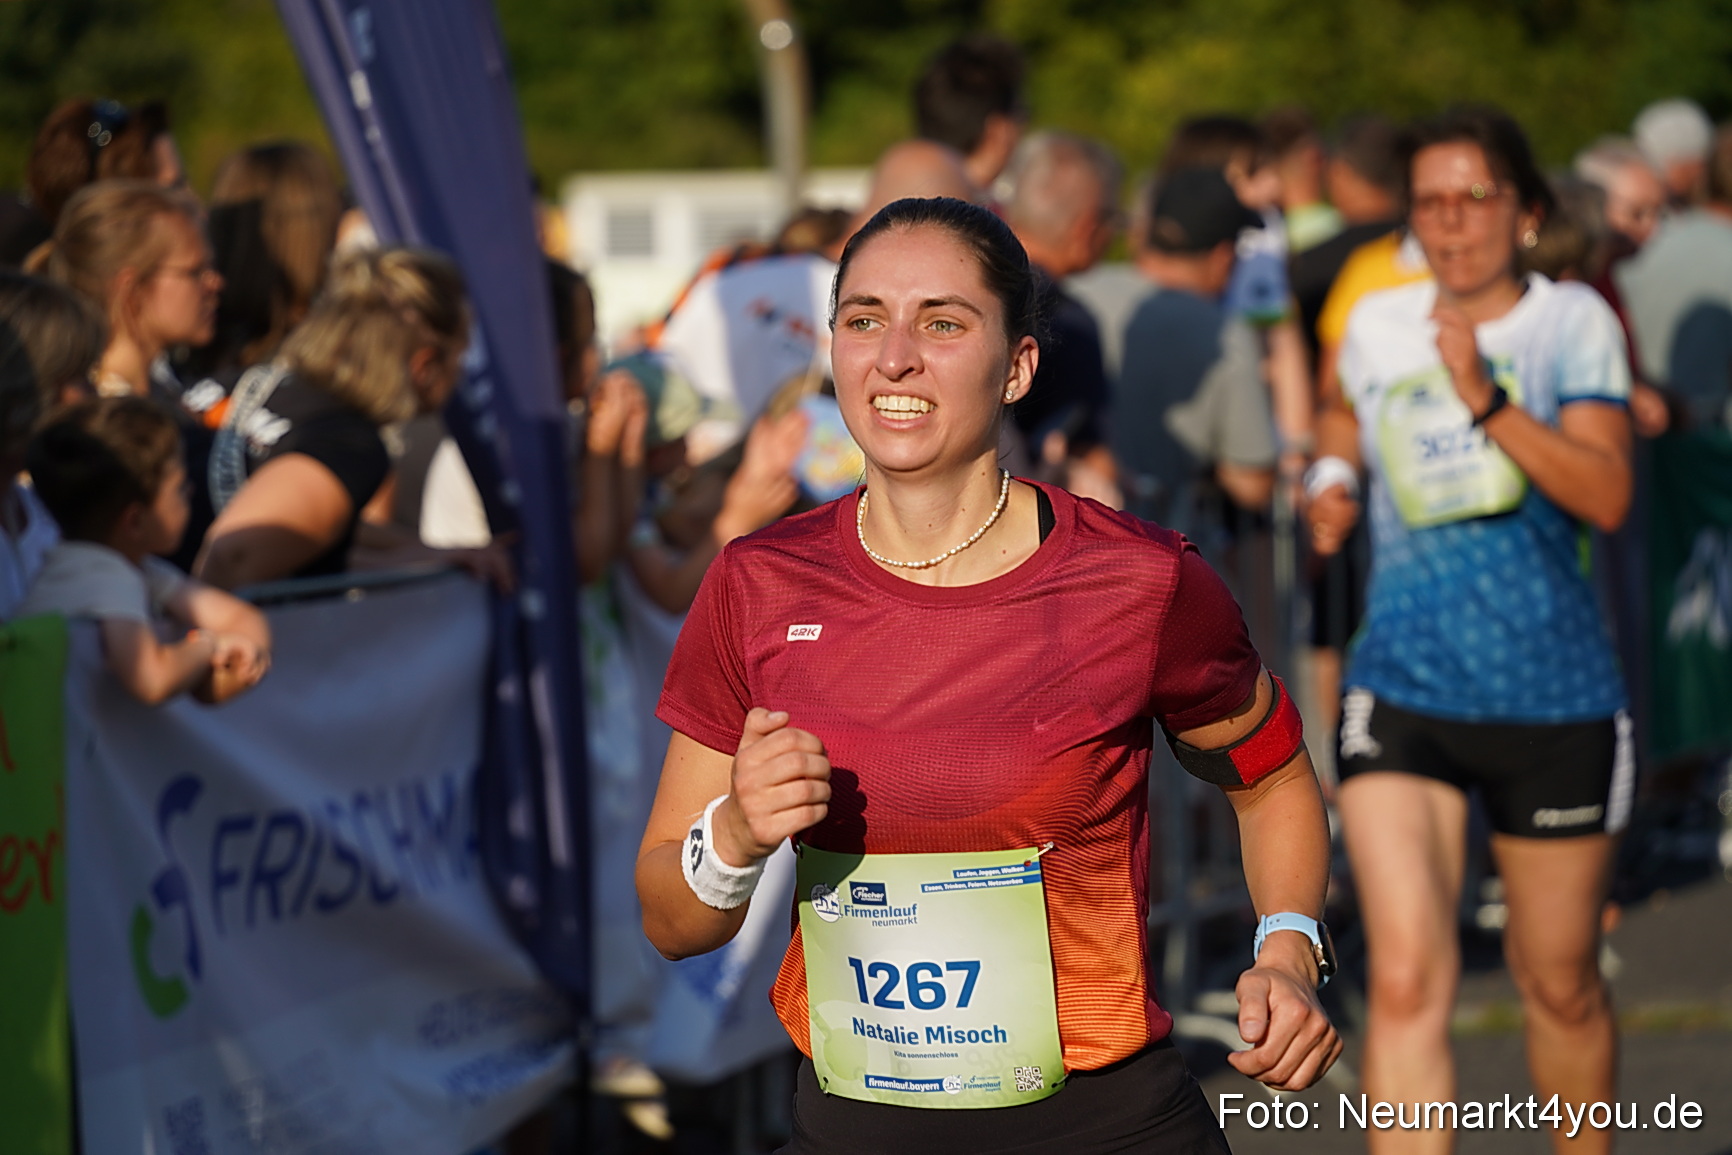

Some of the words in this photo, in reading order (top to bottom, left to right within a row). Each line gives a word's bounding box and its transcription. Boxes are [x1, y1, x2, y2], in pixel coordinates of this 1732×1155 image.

[956, 869, 978, 878] Laufen,
[979, 868, 1001, 877] Joggen,
[1001, 866, 1025, 874] Walken
[854, 888, 885, 900] Fischer
[843, 903, 918, 919] Firmenlauf
[871, 916, 918, 927] neumarkt
[847, 956, 981, 1011] 1267
[851, 1016, 919, 1045] Natalie
[925, 1025, 1008, 1045] Misoch
[894, 1050, 906, 1058] Kita
[907, 1050, 959, 1059] sonnenschloss
[868, 1077, 940, 1092] firmenlauf.bayern
[963, 1080, 1002, 1090] Firmenlauf
